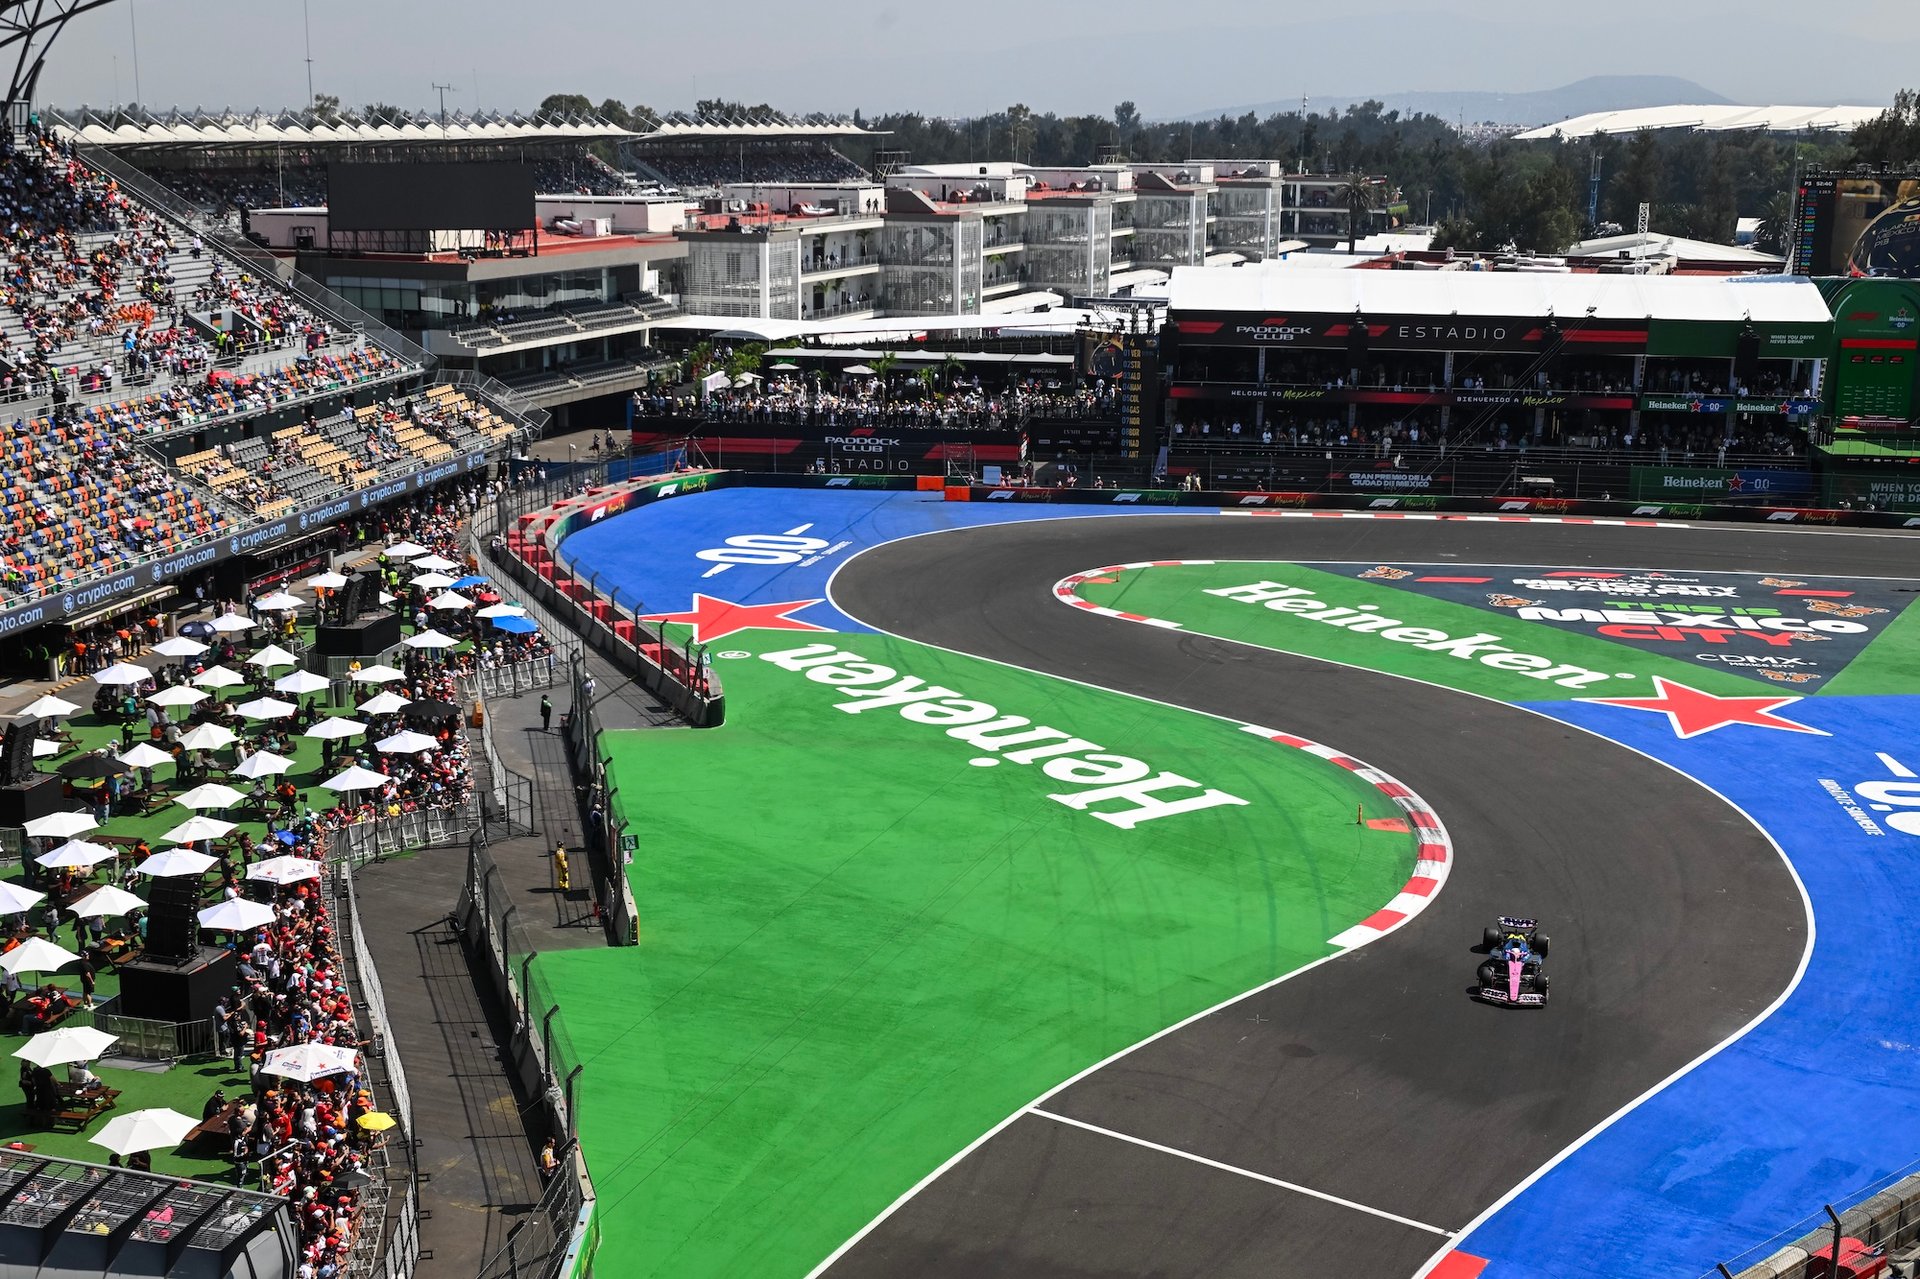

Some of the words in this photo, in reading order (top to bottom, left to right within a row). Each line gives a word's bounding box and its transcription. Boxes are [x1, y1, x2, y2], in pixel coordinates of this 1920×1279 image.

[1876, 226, 1916, 241] MEXICO
[1236, 326, 1311, 335] PADDOCK
[1254, 333, 1294, 341] CLUB
[1399, 326, 1506, 341] ESTADIO
[1282, 388, 1325, 400] Mexico
[1522, 396, 1566, 406] Mexico
[1648, 401, 1687, 410] Heineken
[1736, 403, 1775, 412] Heineken
[825, 436, 901, 446] PADDOCK
[842, 444, 884, 453] CLUB
[424, 462, 458, 484] crypto.com
[1349, 472, 1374, 480] GRAN
[1374, 473, 1408, 481] PREMIO
[1351, 479, 1382, 487] CIUDAD
[1664, 475, 1723, 488] Heineken
[1870, 482, 1904, 492] WHEN
[369, 480, 406, 502] crypto.com
[309, 500, 350, 524] crypto.com
[241, 523, 287, 548] crypto.com
[164, 546, 216, 574] crypto.com
[1512, 578, 1651, 588] MEXICO
[1657, 583, 1737, 592] CITY
[1630, 575, 1699, 583] Heineken
[77, 575, 135, 605] crypto.com
[1525, 583, 1650, 593] GRAND
[1654, 588, 1740, 598] PRIX
[1604, 601, 1725, 614] THIS
[1732, 607, 1782, 617] IS
[1517, 607, 1868, 634] MEXICO
[1202, 580, 1610, 689] Heineken
[1597, 625, 1793, 647] CITY
[1696, 653, 1807, 666] CDMX
[759, 643, 1251, 830] Heineken
